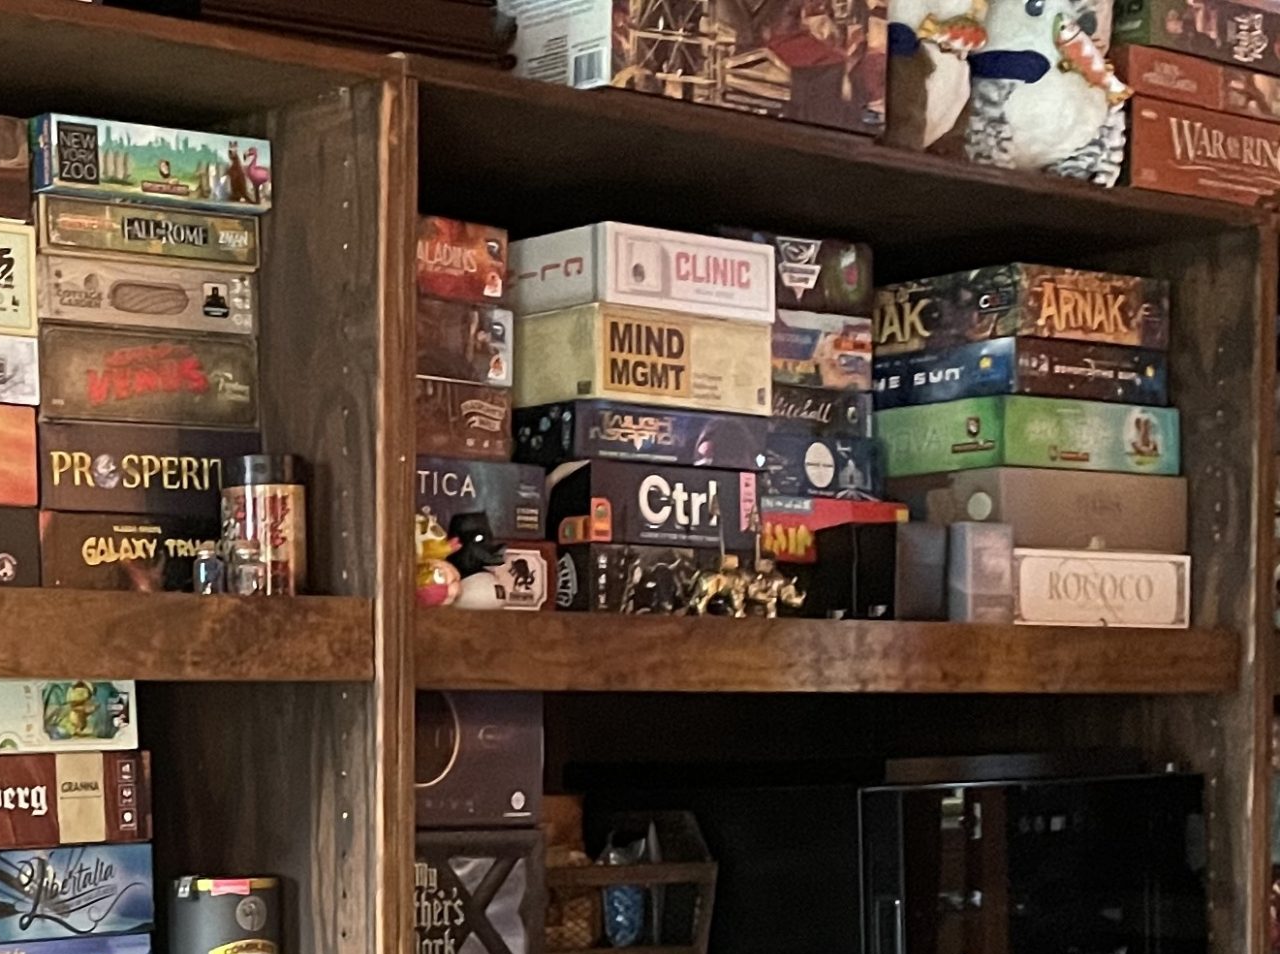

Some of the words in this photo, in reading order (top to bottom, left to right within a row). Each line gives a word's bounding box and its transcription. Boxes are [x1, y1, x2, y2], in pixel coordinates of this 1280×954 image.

[59, 131, 96, 149] NEW
[1169, 117, 1227, 162] WAR
[1242, 136, 1280, 169] RIN
[61, 161, 97, 181] ZOO
[123, 217, 157, 239] FALL
[416, 239, 478, 274] ALADINS
[675, 250, 752, 290] CLINIC
[1036, 281, 1129, 335] ARNAK
[609, 320, 686, 360] MIND
[609, 358, 686, 392] MGMT
[772, 396, 832, 424] hitehall
[50, 450, 222, 491] PROSPERIT
[417, 470, 477, 499] TICA
[638, 474, 718, 527] Ctrl
[82, 536, 158, 566] GALAXY
[414, 887, 466, 932] ther's
